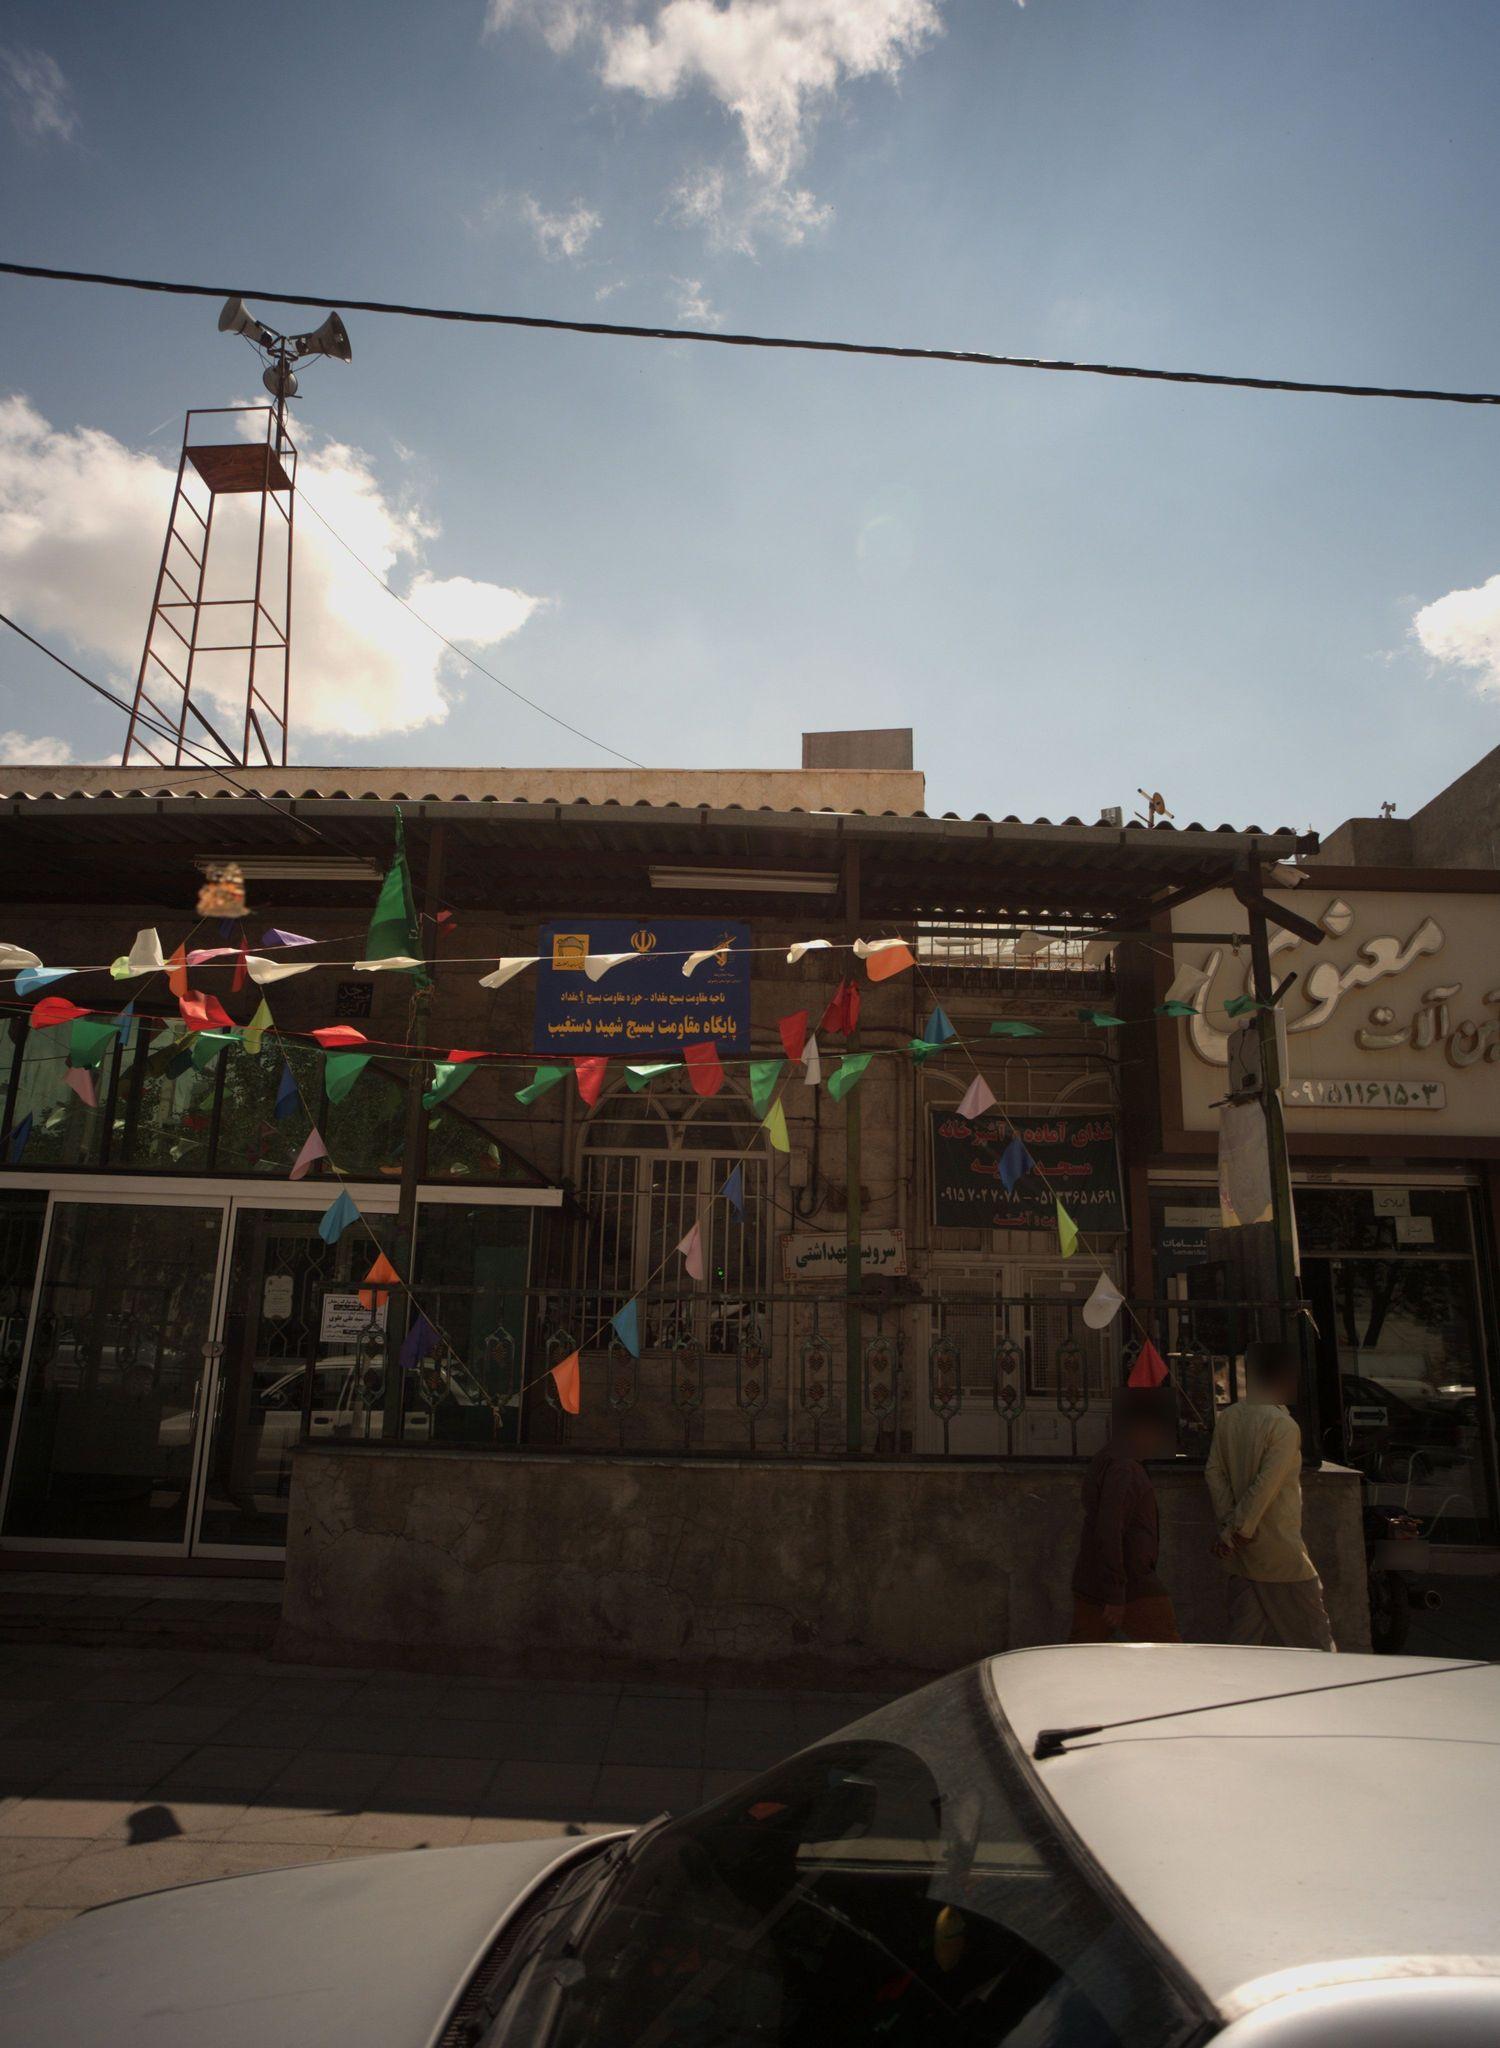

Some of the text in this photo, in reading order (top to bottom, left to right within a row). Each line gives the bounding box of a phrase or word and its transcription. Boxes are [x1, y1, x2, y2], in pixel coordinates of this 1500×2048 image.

[586, 993, 602, 1005] بسیج
[603, 991, 625, 1005] مقاومت
[669, 993, 684, 1005] بسیج
[685, 991, 708, 1005] مقاومت
[547, 1014, 737, 1041] پایگاه مقاومت بسیج شهید دستغیب
[1023, 1120, 1068, 1143] آماده
[1071, 1120, 1113, 1148] غذای
[1033, 1158, 1094, 1182] مسجد
[796, 1241, 848, 1268] بهداشتی
